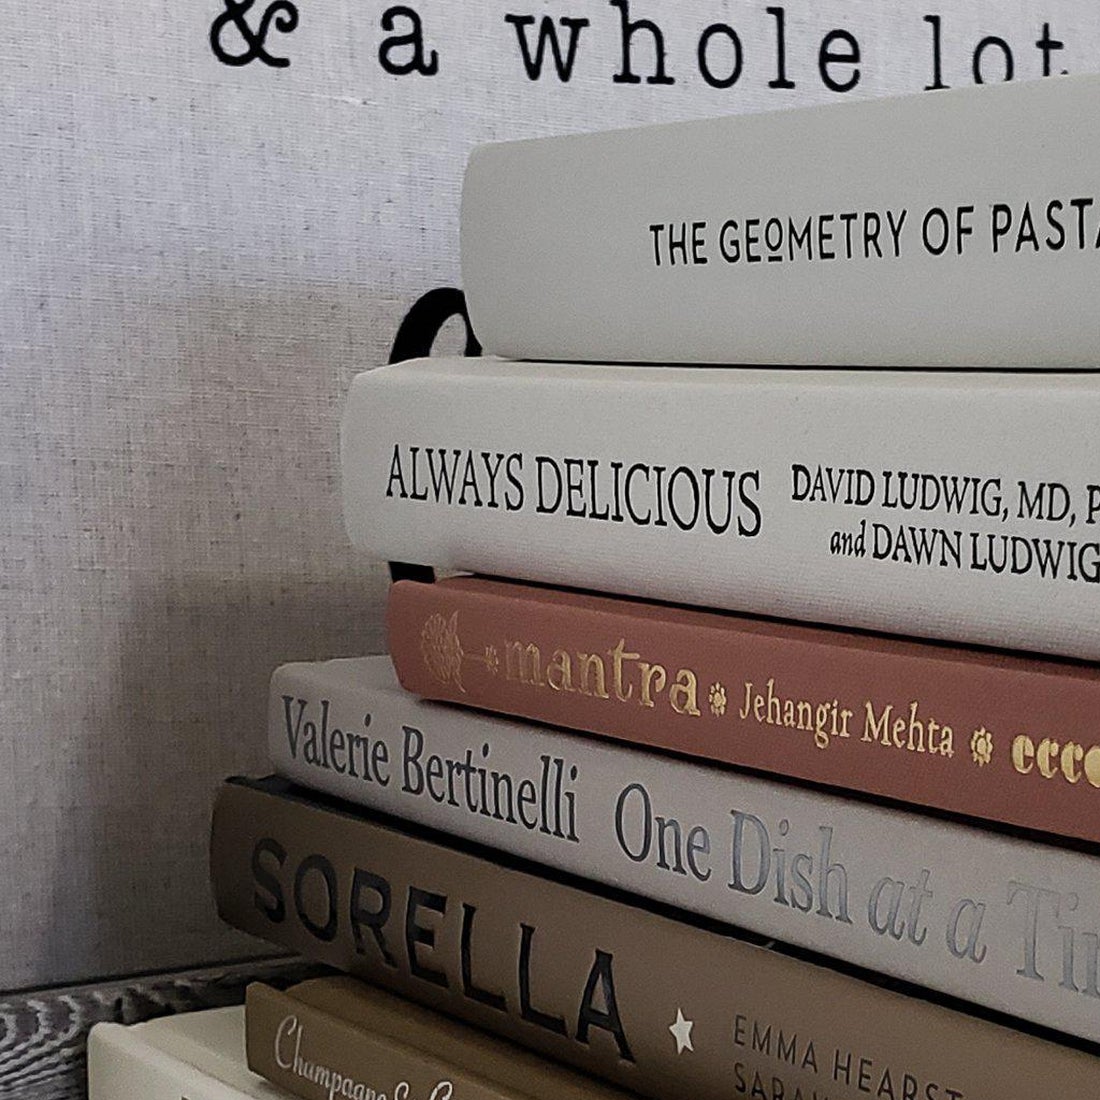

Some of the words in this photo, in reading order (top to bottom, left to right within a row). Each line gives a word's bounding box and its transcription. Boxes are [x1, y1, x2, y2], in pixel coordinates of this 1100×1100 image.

[209, 0, 299, 68] &
[378, 5, 439, 76] a
[505, 0, 861, 92] whole
[923, 15, 1069, 91] lot
[648, 221, 709, 267] THE
[718, 208, 908, 264] GEOMETRY
[921, 205, 975, 256] OF
[385, 443, 524, 512] ALWAYS
[535, 455, 763, 538] DELICIOUS
[791, 463, 876, 506] DAVID
[881, 470, 1009, 523] LUDWIG,
[1016, 480, 1077, 528] MD,
[830, 519, 867, 559] and
[871, 522, 962, 569] DAWN
[504, 637, 701, 717] mantra
[739, 678, 852, 750] Jehangir
[860, 701, 956, 760] Mehta
[281, 694, 391, 788] Valerie
[401, 725, 581, 844] Bertinelli
[614, 782, 712, 883] One
[726, 808, 854, 924] Dish
[867, 867, 934, 946] at
[945, 896, 988, 964] a
[250, 837, 637, 1064] SORELLA
[733, 1013, 819, 1075] EMMA
